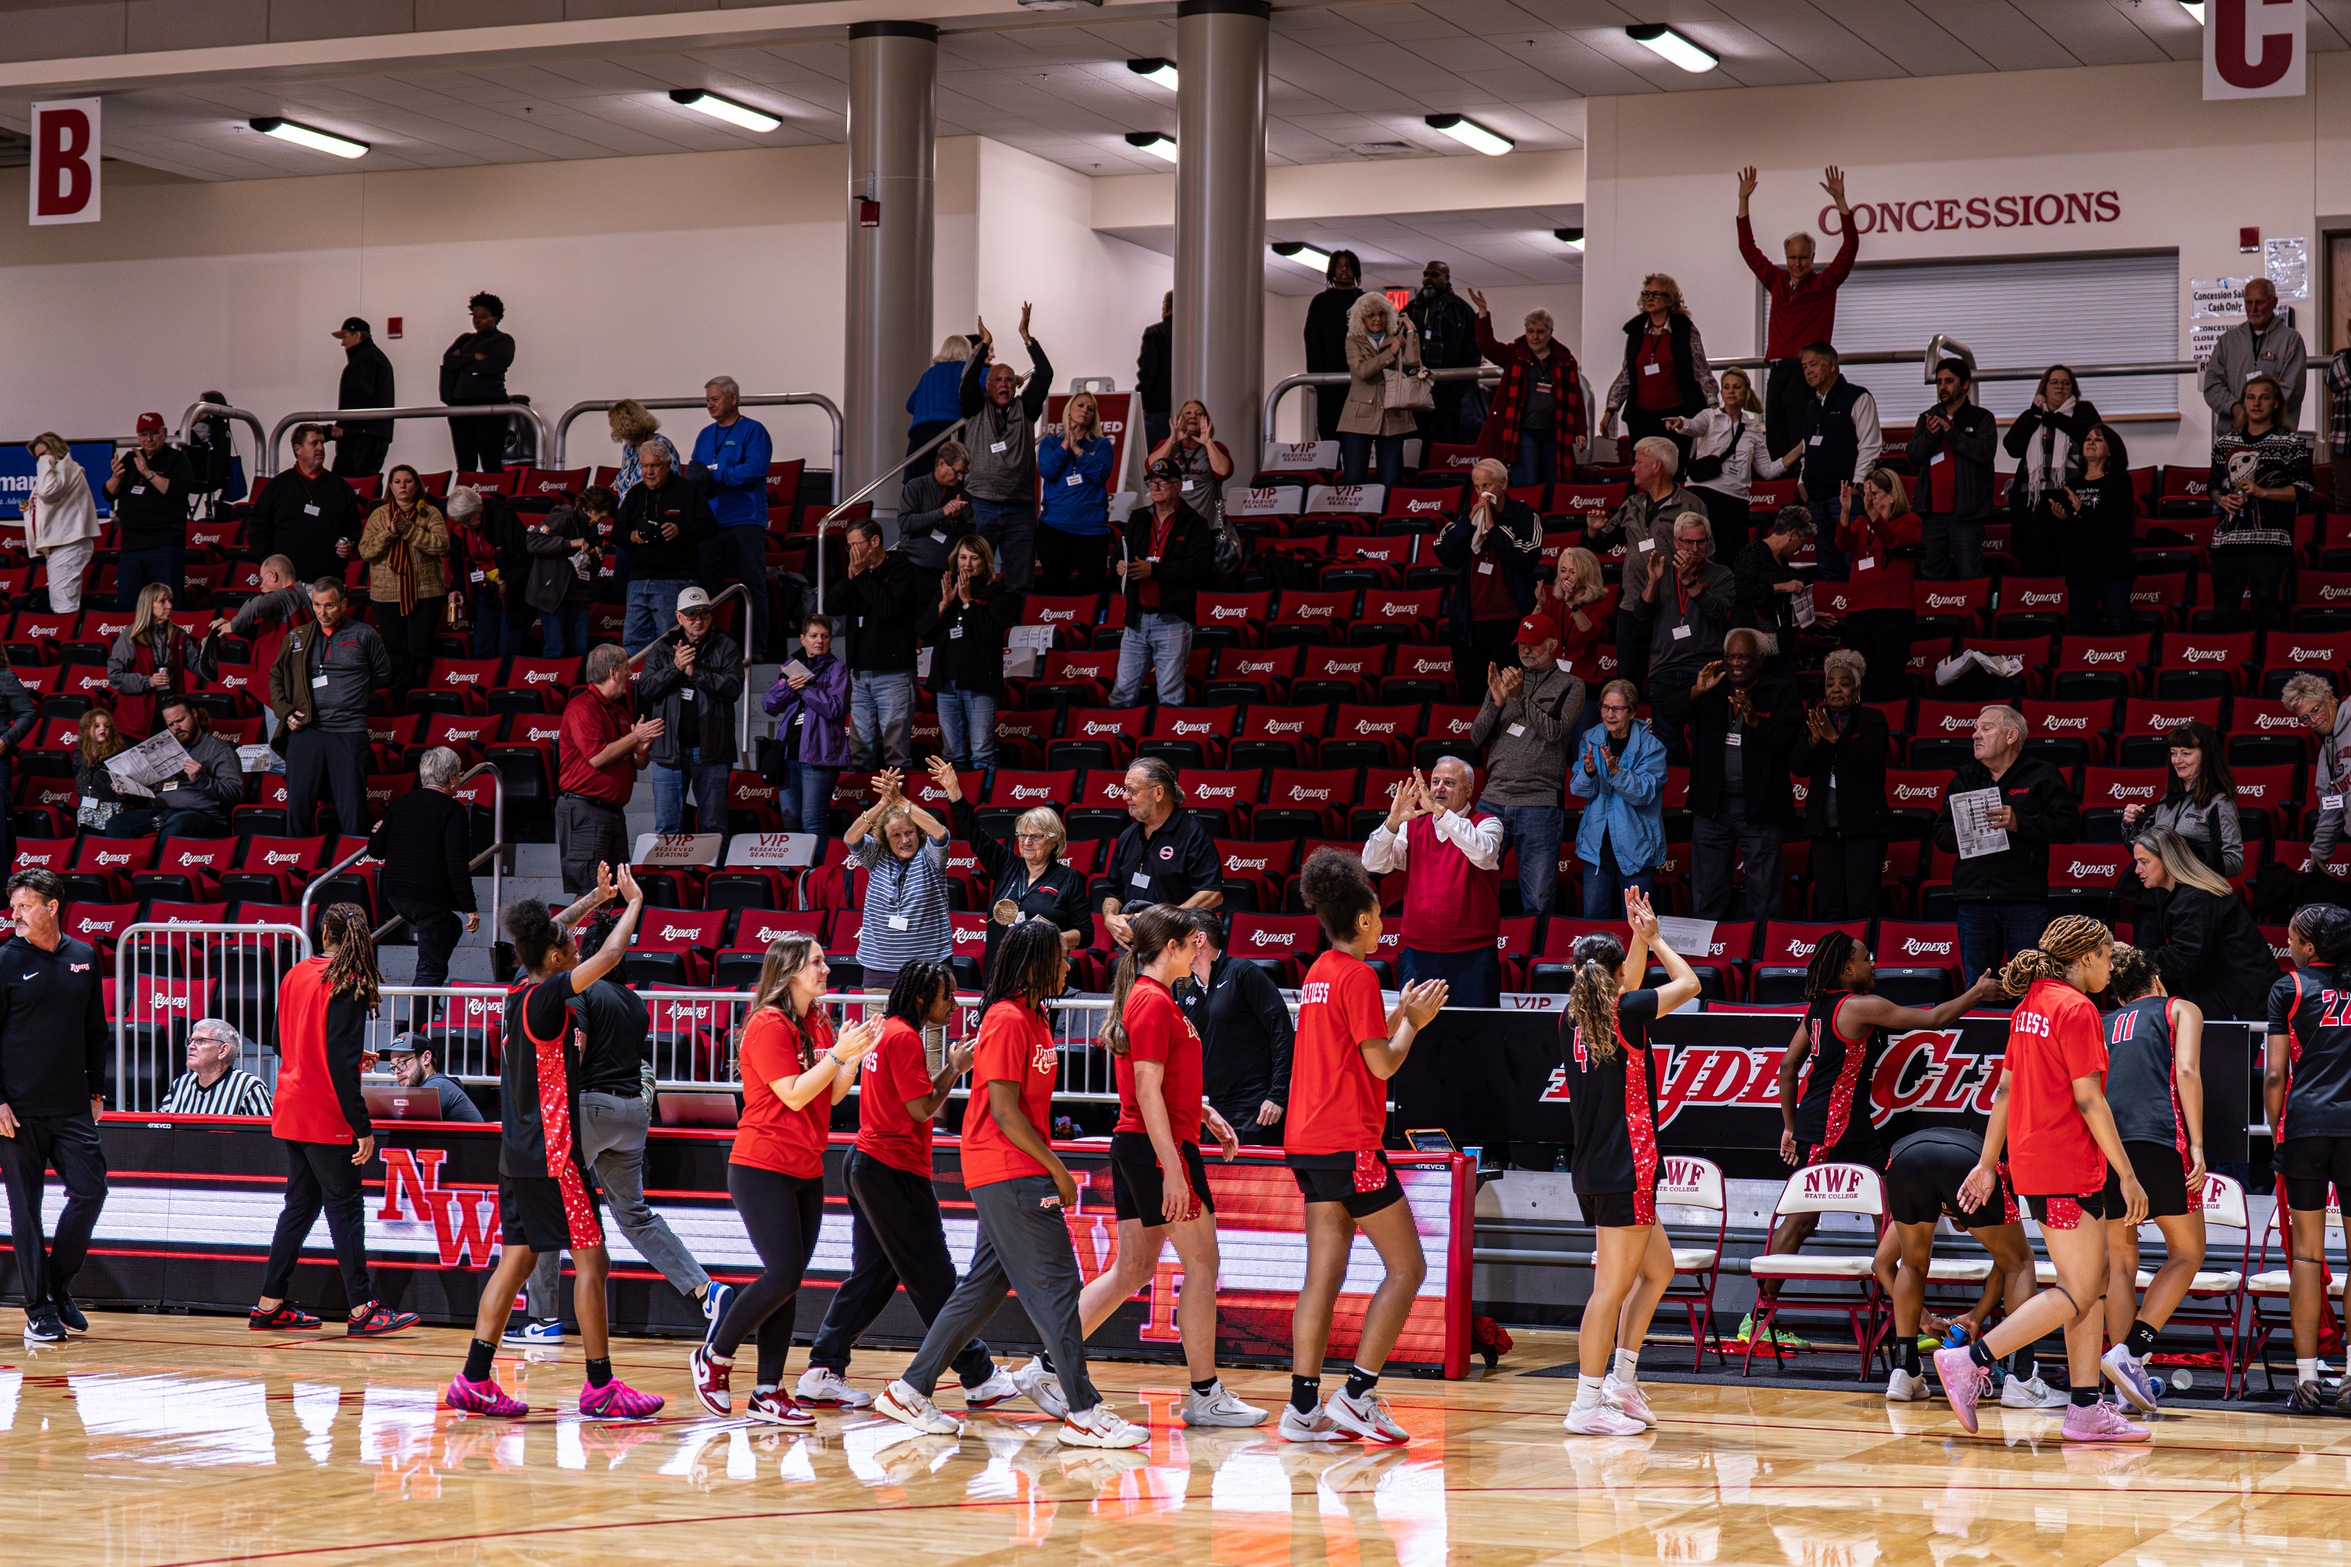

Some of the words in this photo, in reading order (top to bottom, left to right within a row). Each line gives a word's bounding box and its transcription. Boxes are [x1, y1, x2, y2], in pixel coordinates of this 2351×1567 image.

[37, 109, 92, 216] B
[1818, 191, 2121, 235] CONCESSIONS
[2193, 290, 2232, 300] Concession
[2208, 302, 2224, 312] Cash
[2225, 301, 2242, 312] Only
[1290, 442, 1315, 452] VIP
[538, 481, 567, 492] RAIDERS
[1251, 487, 1277, 499] VIP
[1335, 486, 1363, 496] VIP
[1407, 500, 1442, 512] RAIDERS
[1570, 496, 1606, 508] RAIDERS
[192, 533, 220, 544] RAIDERS
[1926, 593, 1967, 607] RAIDERS
[2021, 591, 2062, 604] RAIDERS
[1039, 609, 1075, 622] RAIDERS
[1211, 605, 1248, 619] RAIDERS
[1297, 605, 1334, 618] RAIDERS
[1381, 603, 1419, 616] RAIDERS
[28, 625, 58, 637] RAIDERS
[2083, 649, 2127, 663] RAIDERS
[2182, 647, 2227, 662] RAIDERS
[2288, 647, 2333, 662] RAIDERS
[1062, 665, 1099, 678] RAIDERS
[1237, 661, 1275, 674] RAIDERS
[1324, 660, 1362, 674] RAIDERS
[1413, 659, 1453, 672] RAIDERS
[445, 672, 479, 684] RAIDERS
[524, 671, 558, 683] RAIDERS
[1082, 721, 1122, 735] RAIDERS
[1172, 721, 1211, 734] RAIDERS
[1264, 719, 1304, 734] RAIDERS
[1355, 720, 1396, 734] RAIDERS
[1447, 719, 1472, 732] RAID
[1940, 716, 1977, 729] RAIDER
[2042, 715, 2088, 730] RAIDERS
[444, 728, 479, 741] RAIDERS
[735, 785, 774, 800] RAIDERS
[1010, 785, 1050, 799] RAIDERS
[1194, 784, 1236, 798] RAIDERS
[1288, 785, 1330, 800] RAIDERS
[1894, 784, 1939, 799] RAIDERS
[2108, 783, 2156, 799] RAIDERS
[663, 834, 694, 846] VIP
[759, 834, 789, 847] VIP
[16, 852, 51, 866] RAIDERS
[95, 851, 131, 865] RAIDERS
[178, 852, 214, 866] RAIDERS
[263, 851, 301, 865] RAIDERS
[1224, 855, 1268, 870] RAIDERS
[2067, 861, 2117, 878] RAIDERS
[77, 918, 115, 933] RAIDERS
[659, 925, 701, 941] RAIDERS
[953, 928, 986, 943] RAIDER
[1250, 930, 1296, 946] RAIDERS
[1787, 940, 1816, 956] RAID
[1901, 938, 1952, 955] RAIDERS
[1513, 996, 1551, 1009] VIP
[2112, 1010, 2139, 1044] 11
[1804, 1166, 1864, 1193] NWF
